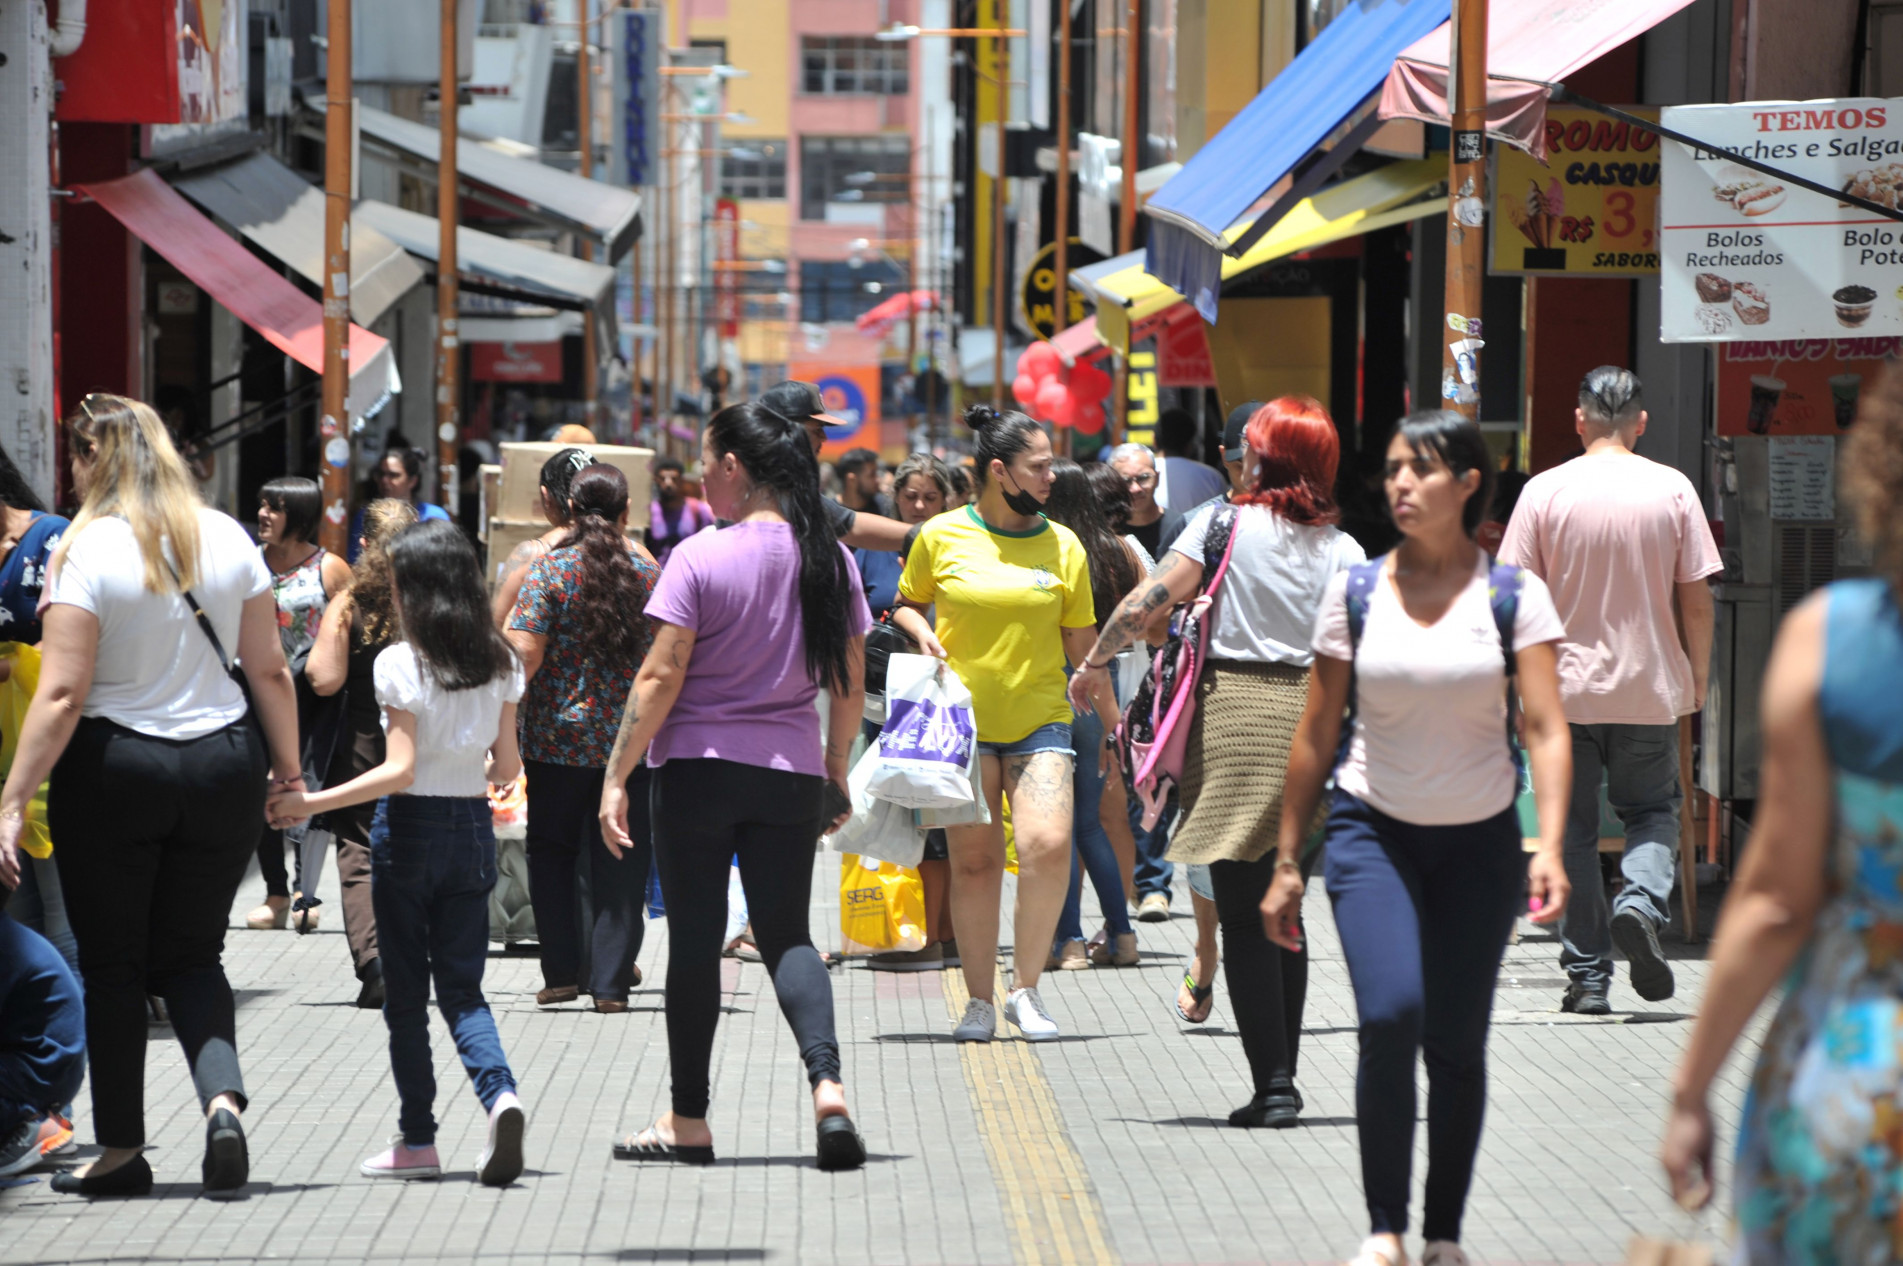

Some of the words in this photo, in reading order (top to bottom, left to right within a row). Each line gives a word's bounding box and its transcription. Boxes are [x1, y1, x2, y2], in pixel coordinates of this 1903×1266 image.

[1753, 107, 1887, 132] TEMOS
[1806, 143, 1820, 157] e
[1828, 136, 1903, 162] Salga
[1565, 161, 1661, 187] CASQU
[1559, 215, 1595, 244] R$
[1706, 231, 1764, 248] Bolos
[1843, 228, 1893, 247] Bolo
[1592, 252, 1661, 268] SABOR
[1686, 250, 1784, 267] Recheados
